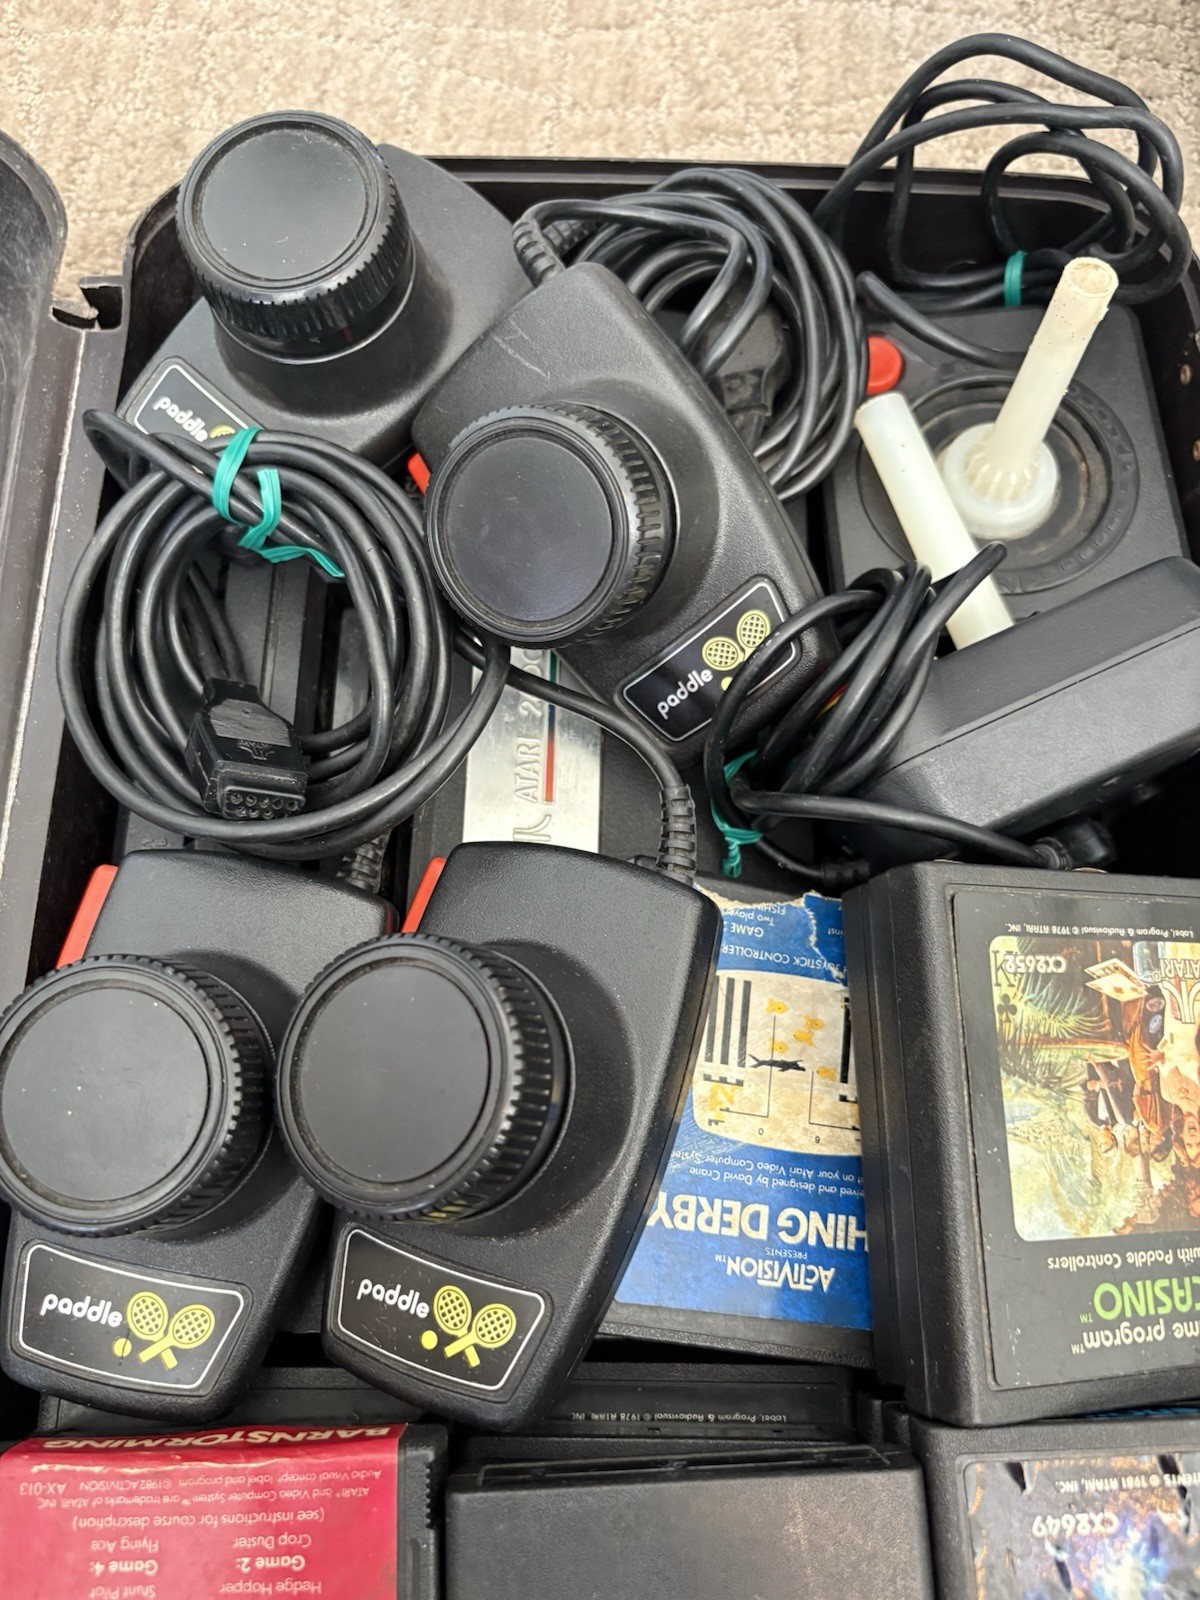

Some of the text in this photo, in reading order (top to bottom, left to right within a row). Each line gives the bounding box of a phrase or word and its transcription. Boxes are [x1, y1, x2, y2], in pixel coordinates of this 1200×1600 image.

[152, 395, 209, 443] paddle
[657, 668, 714, 720] paddle
[514, 736, 541, 803] ATARI
[757, 914, 774, 926] Two
[730, 923, 764, 938] GAME
[1052, 925, 1070, 934] 1978
[1081, 926, 1125, 936] Audiovisual
[1127, 928, 1133, 936] &
[1136, 926, 1168, 937] Program
[1170, 928, 1193, 937] Label,
[721, 944, 789, 964] CONTROLLER
[1004, 954, 1066, 973] CX2652
[705, 1155, 754, 1171] Computer
[757, 1162, 785, 1175] Video
[789, 1167, 814, 1178] Atari
[818, 1169, 840, 1179] your
[843, 1174, 854, 1182] on
[689, 1167, 865, 1197] eived and designed by David Crane
[646, 1191, 868, 1252] HING DERBY
[765, 1247, 807, 1259] PRESENTS
[1126, 1249, 1173, 1266] Paddle
[1048, 1253, 1122, 1272] Controllers
[356, 1278, 430, 1319] paddle
[39, 1293, 124, 1328] paddle
[620, 1412, 640, 1421] 1978
[654, 1413, 704, 1422] Audiovisual
[708, 1414, 715, 1422] &
[717, 1412, 756, 1422] Program
[41, 1425, 390, 1450] BARNSTORMING
[248, 1475, 273, 1485] label
[320, 1471, 349, 1481] Visual
[351, 1469, 381, 1479] Audio
[79, 1480, 139, 1491] ACTIVISION
[178, 1475, 223, 1487] program
[225, 1476, 245, 1486] and
[1121, 1475, 1147, 1488] 1981
[20, 1481, 67, 1495] AX-013
[280, 1489, 310, 1499] Video
[312, 1488, 332, 1498] and
[91, 1497, 102, 1506] of
[105, 1495, 160, 1506] trademarks
[163, 1495, 180, 1504] are
[228, 1490, 277, 1502] Computer
[72, 1507, 325, 1531] (see instructions for course description)
[1032, 1511, 1119, 1538] CX2649
[90, 1535, 159, 1553] Flying Ace
[232, 1532, 311, 1550] Crop Duster
[89, 1559, 158, 1576] Game 4:
[235, 1555, 305, 1571] Game 2:
[123, 1585, 156, 1599] Stunt
[219, 1579, 322, 1596] Hedge Hopper
